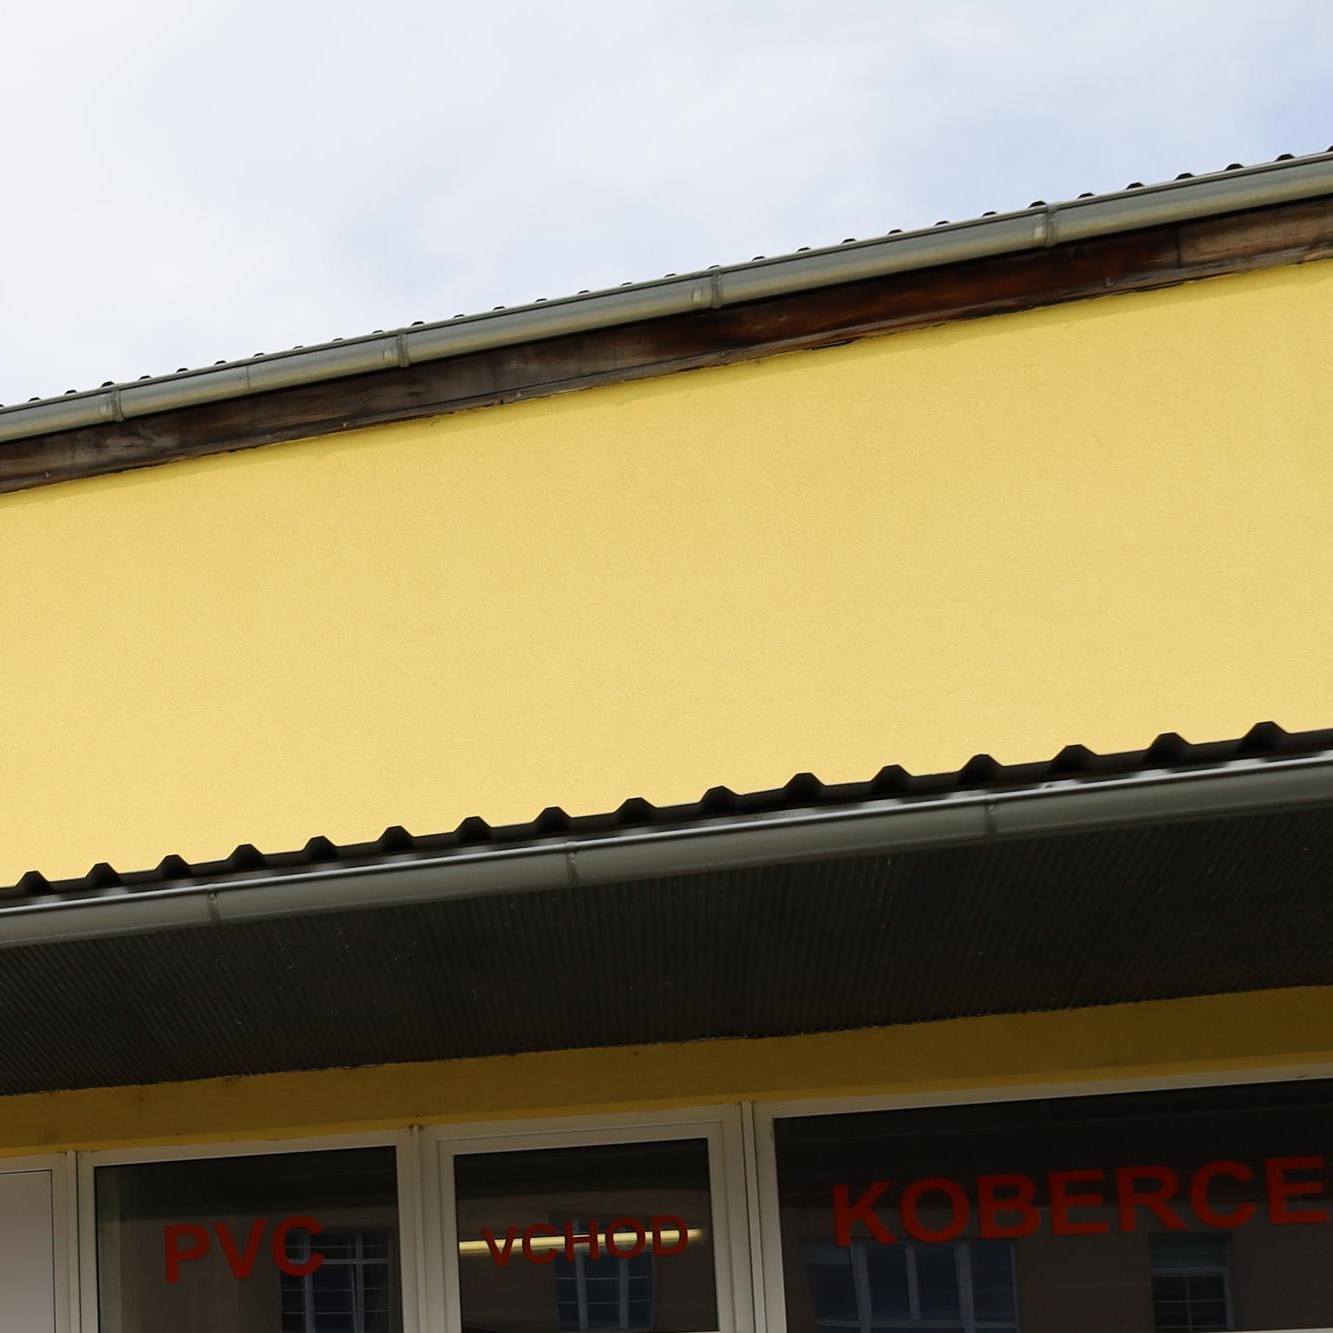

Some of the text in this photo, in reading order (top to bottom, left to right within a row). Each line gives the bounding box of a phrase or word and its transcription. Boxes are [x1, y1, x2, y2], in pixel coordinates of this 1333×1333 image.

[833, 1155, 1330, 1248] KOBERCE
[163, 1216, 325, 1284] PVC
[481, 1214, 690, 1268] VCHOD
